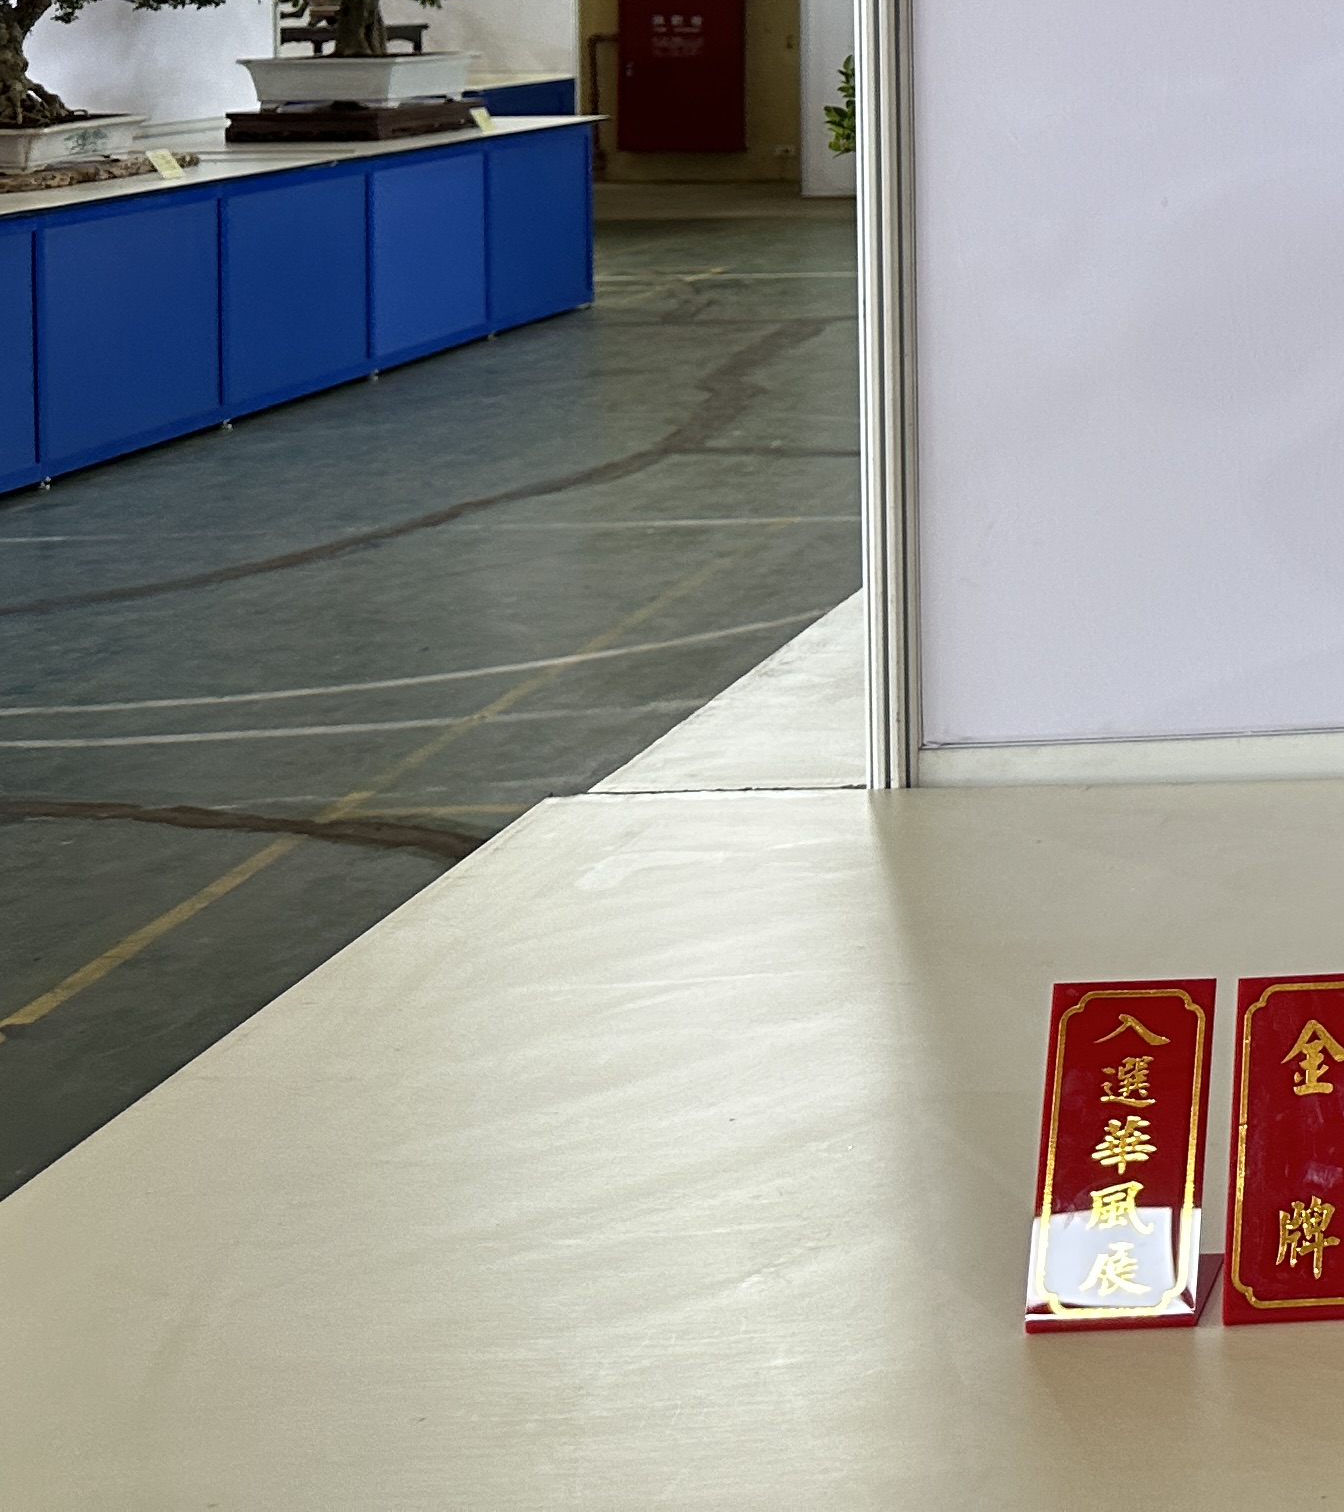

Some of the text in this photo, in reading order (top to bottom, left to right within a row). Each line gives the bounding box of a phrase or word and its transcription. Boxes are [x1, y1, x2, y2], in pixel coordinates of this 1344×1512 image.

[1079, 1013, 1171, 1297] 入選華風展
